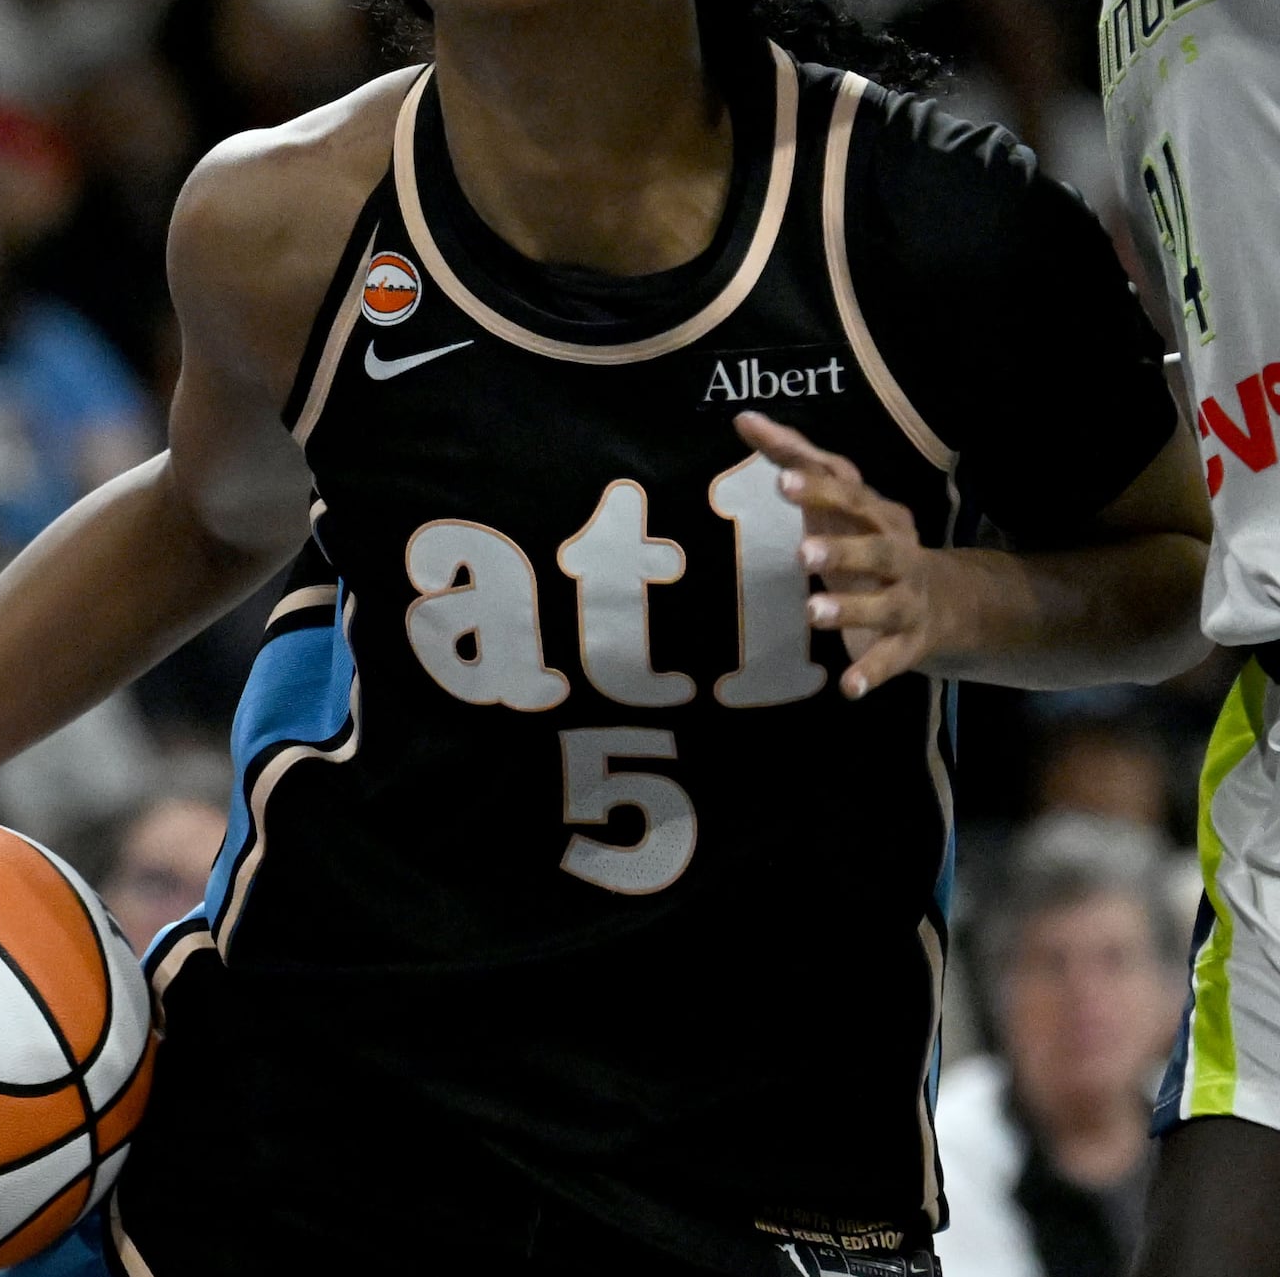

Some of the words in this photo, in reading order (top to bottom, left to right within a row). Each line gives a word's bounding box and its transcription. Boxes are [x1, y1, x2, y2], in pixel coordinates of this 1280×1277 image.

[703, 356, 845, 403] Albert
[405, 448, 828, 712] atl
[559, 726, 698, 896] 5
